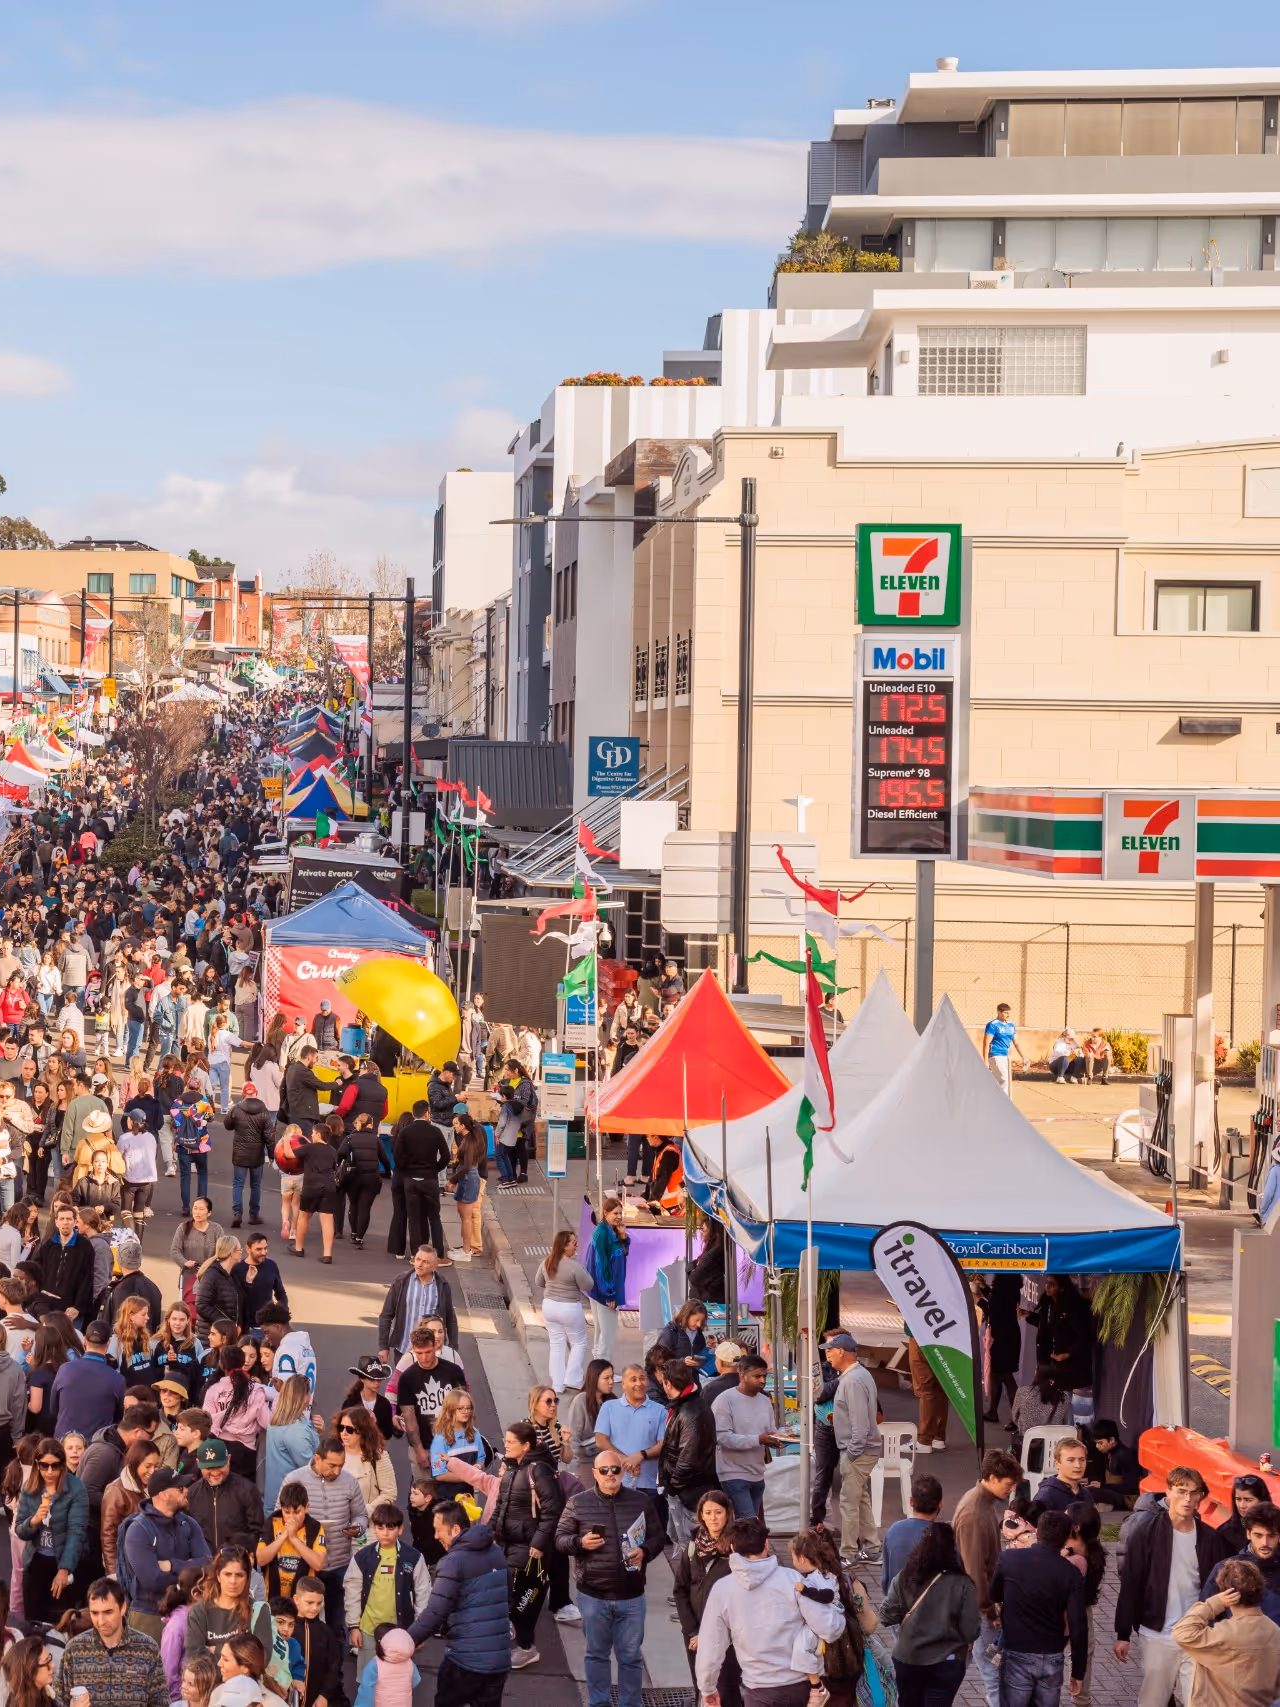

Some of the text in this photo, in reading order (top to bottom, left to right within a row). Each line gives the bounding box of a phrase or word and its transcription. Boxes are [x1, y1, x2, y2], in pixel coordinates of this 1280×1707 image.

[873, 647, 945, 670] Mobil
[869, 683, 936, 693] Unleaded E10
[880, 694, 946, 723] 172.5
[868, 725, 914, 735] Unleaded
[880, 736, 945, 765] 174.5
[917, 768, 931, 778] 98
[879, 779, 945, 808] 195.5
[867, 809, 938, 820] Diesel Efficient
[297, 869, 397, 878] Private Events tering
[327, 948, 361, 963] Cheeky
[960, 1260, 1044, 1268] TERNATIONAL
[883, 1232, 958, 1339] itravel
[282, 1557, 298, 1565] LAND
